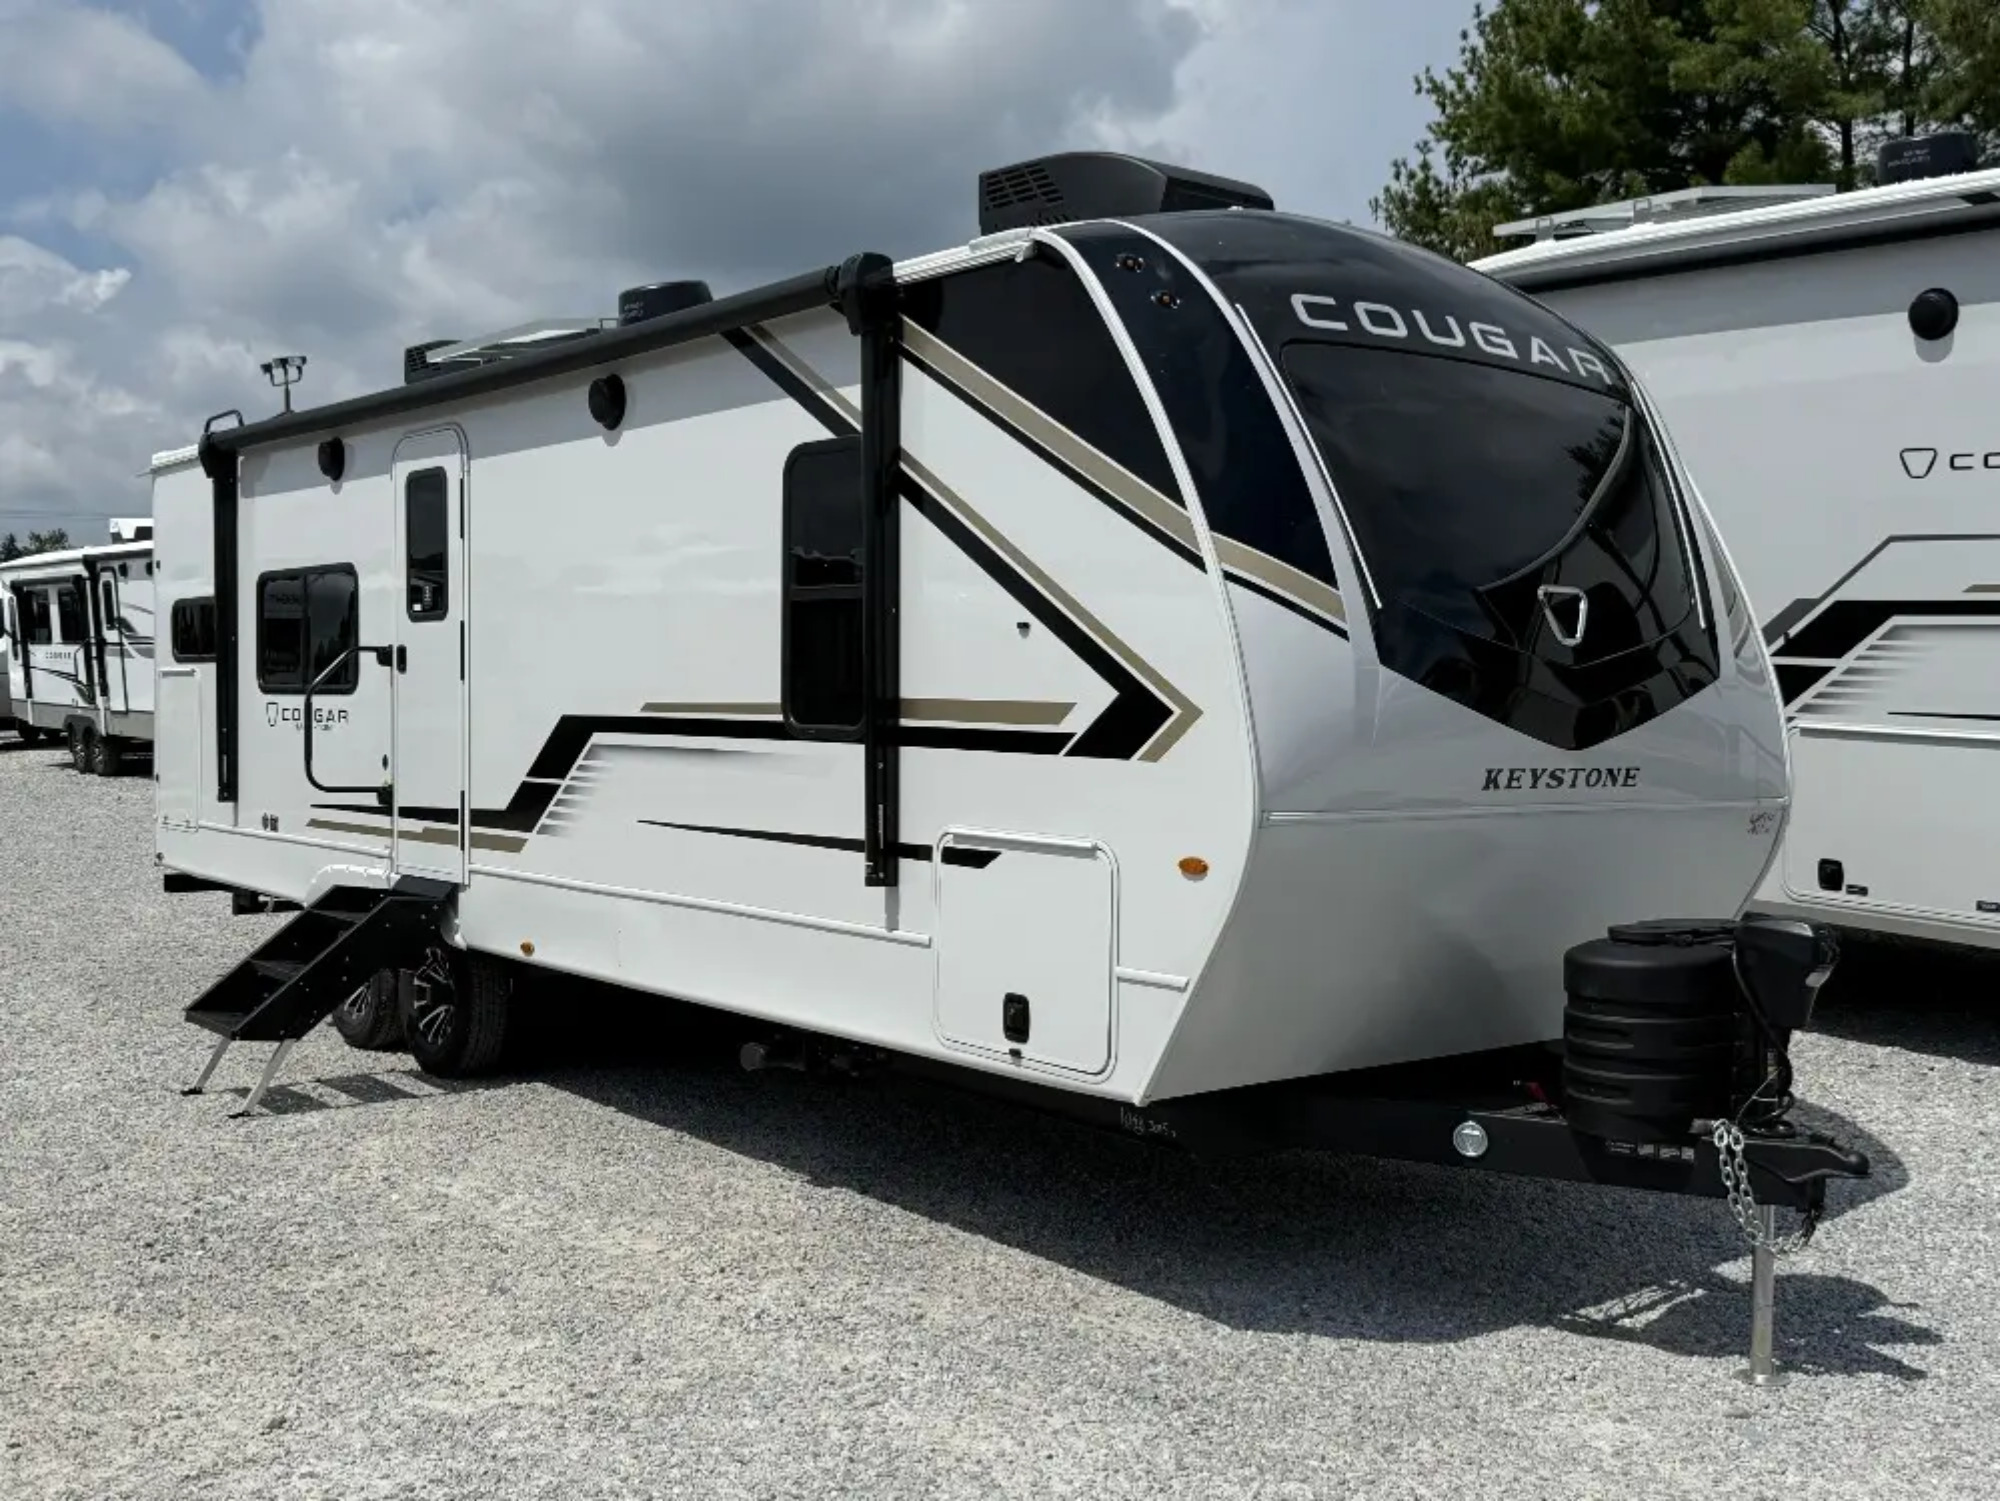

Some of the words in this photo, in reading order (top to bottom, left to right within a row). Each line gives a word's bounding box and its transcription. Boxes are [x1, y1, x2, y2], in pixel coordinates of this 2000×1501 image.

[1290, 293, 1613, 385] COUGAR
[281, 707, 349, 723] COGAR
[1481, 767, 1641, 791] KEYSTONE
